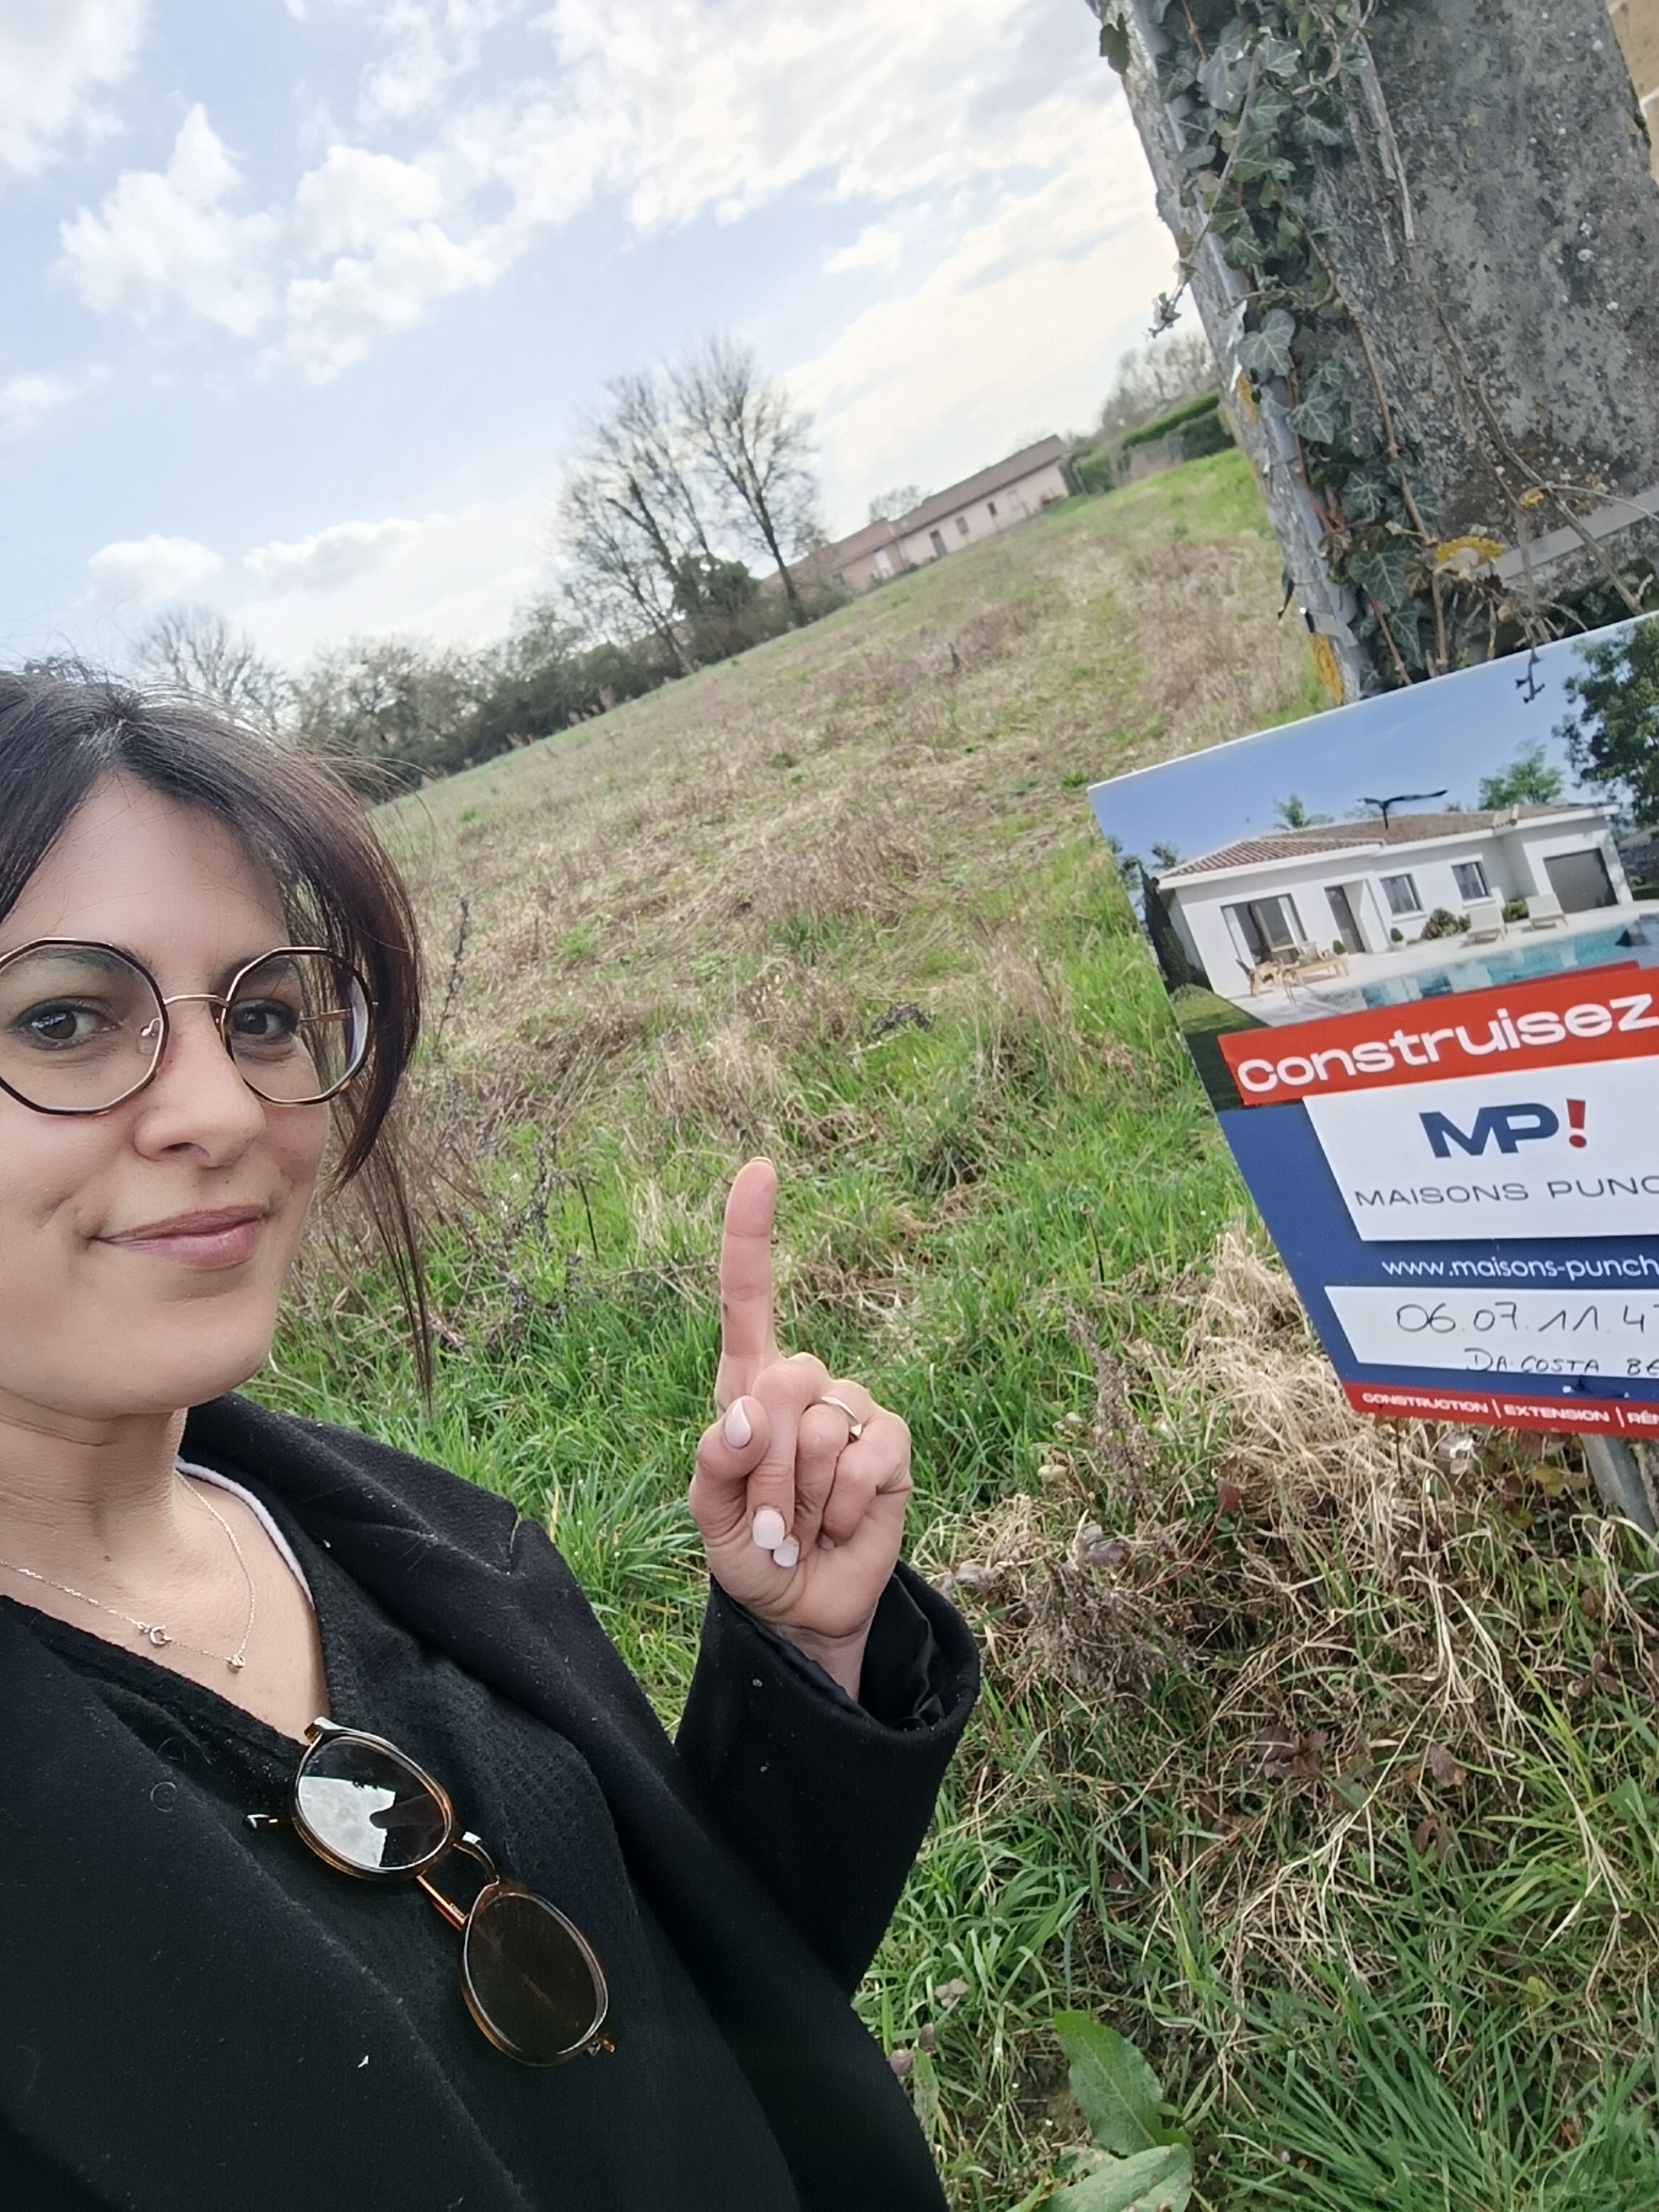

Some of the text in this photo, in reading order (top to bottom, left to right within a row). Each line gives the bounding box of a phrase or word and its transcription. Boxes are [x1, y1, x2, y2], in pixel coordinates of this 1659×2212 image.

[1238, 993, 1659, 1092] construisez
[1355, 1183, 1528, 1206] MAISONS
[1382, 1254, 1659, 1281] www.maisons-punch
[1396, 1301, 1659, 1333] 06.07.11.4
[1362, 1392, 1489, 1413] CONSTRUCTION
[1503, 1404, 1610, 1422] EXTENSION
